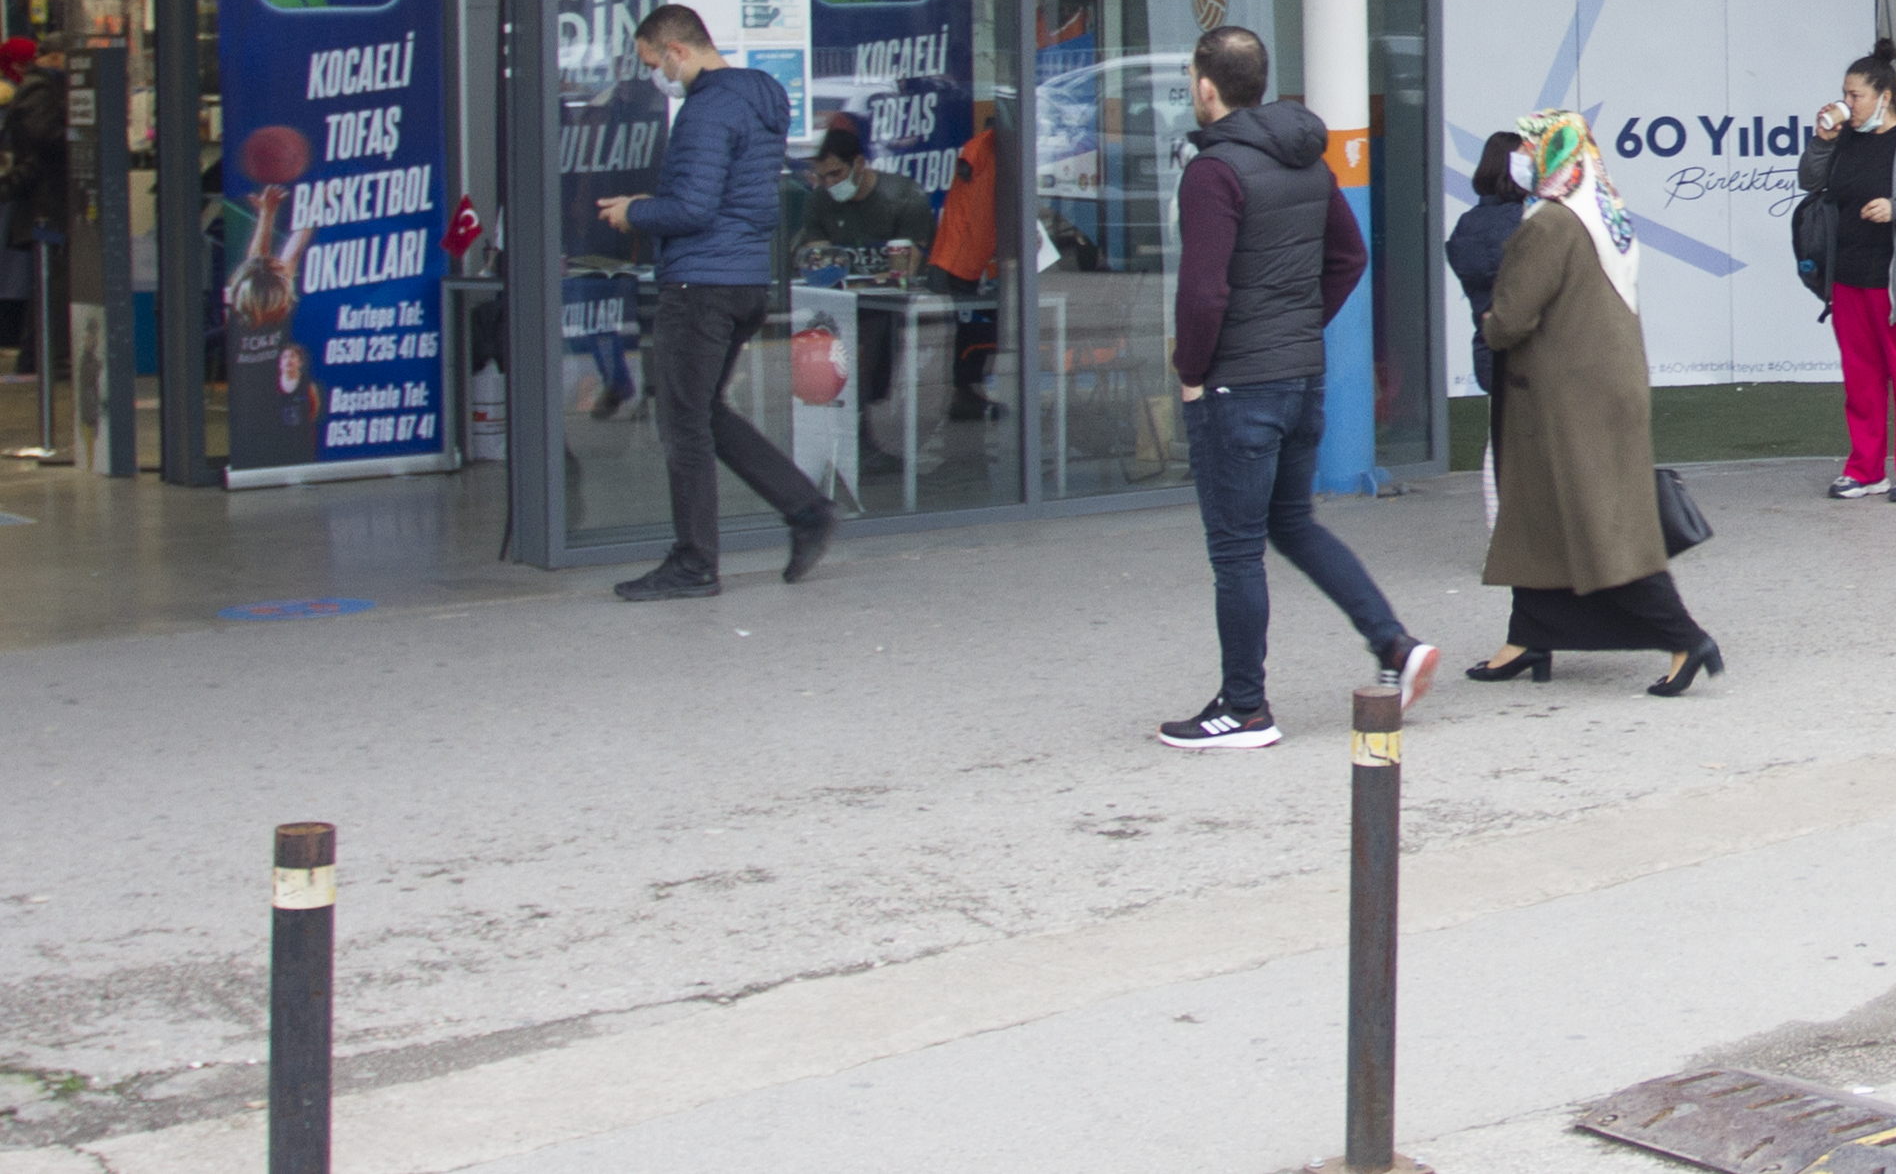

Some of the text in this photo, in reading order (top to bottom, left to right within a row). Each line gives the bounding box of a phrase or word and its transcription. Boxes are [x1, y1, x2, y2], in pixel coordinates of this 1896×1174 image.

[306, 30, 416, 101] KOCAELİ
[854, 23, 949, 85] KOCAELİ
[324, 104, 402, 162] TOFAŞ
[870, 91, 938, 143] TOFAŞ
[1615, 116, 1687, 159] 60
[559, 120, 661, 174] ULLARI
[290, 164, 434, 232] BASKETBOL
[1663, 166, 1808, 217] Birliktey
[302, 228, 428, 295] OKULLARI
